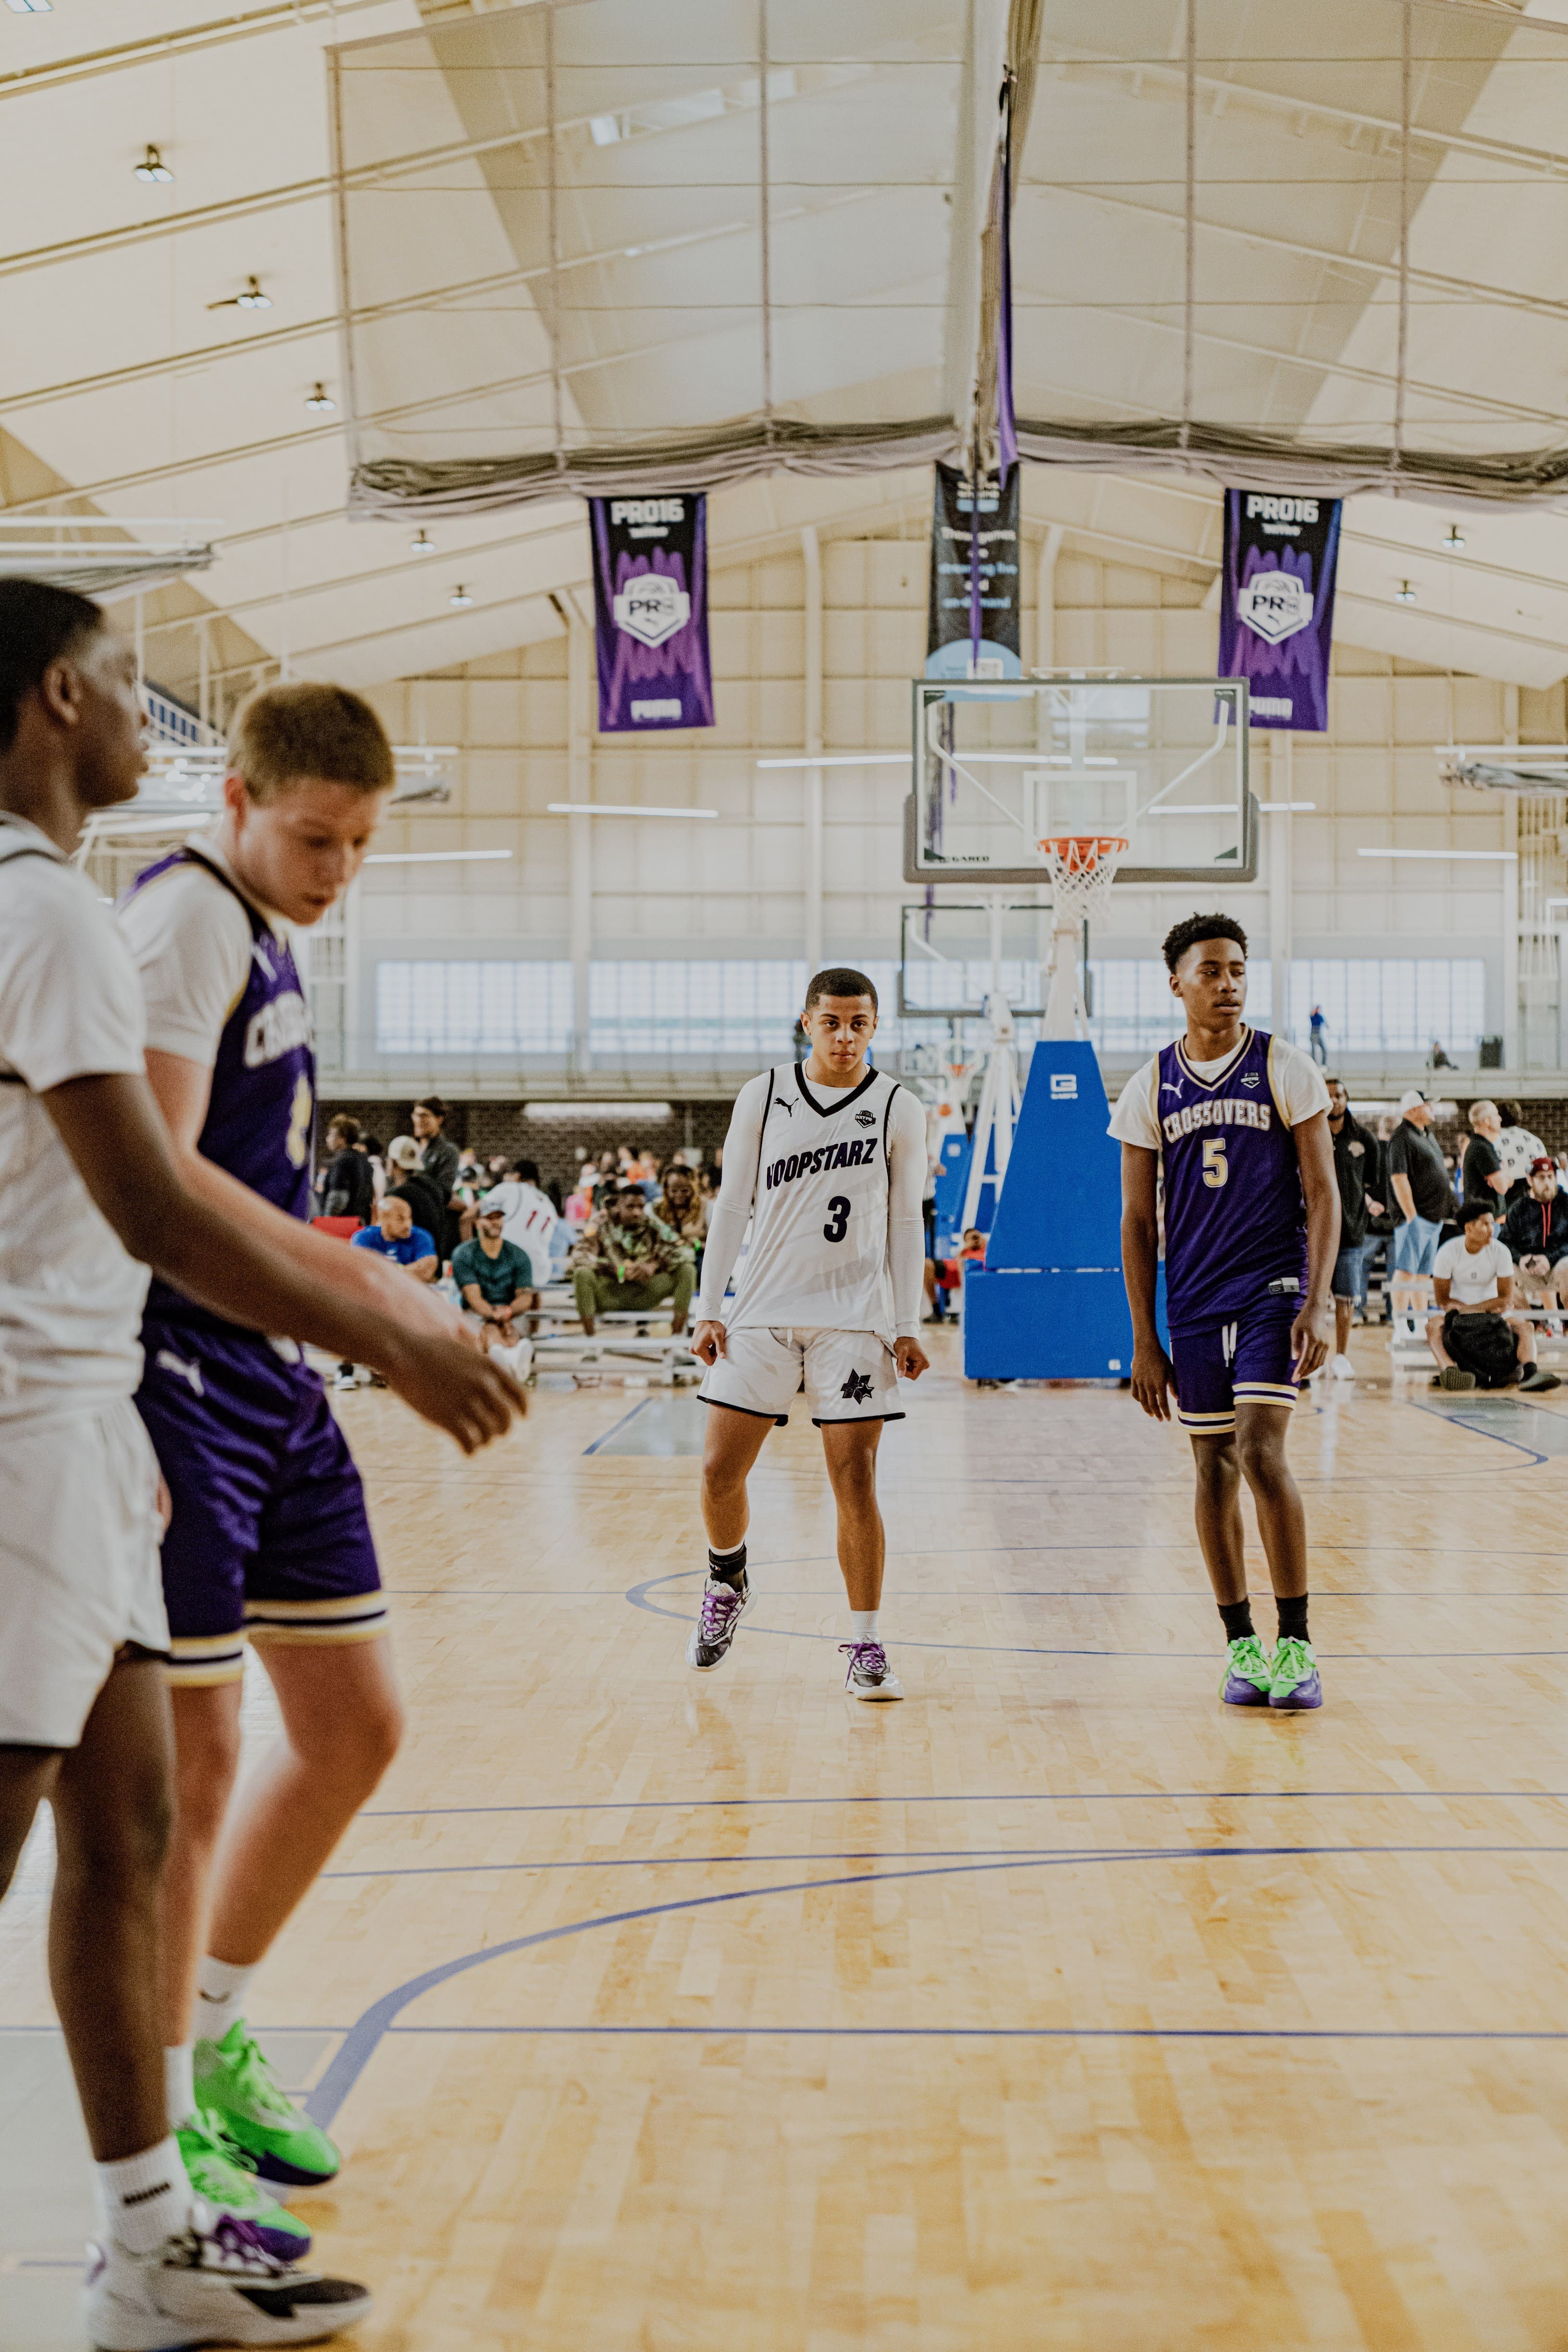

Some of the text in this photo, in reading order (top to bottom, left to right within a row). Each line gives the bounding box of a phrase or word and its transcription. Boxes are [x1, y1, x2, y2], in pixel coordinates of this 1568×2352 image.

[1163, 1098, 1271, 1143] CROSSOVERS
[1203, 1138, 1228, 1188] 5
[823, 1195, 851, 1243] 3
